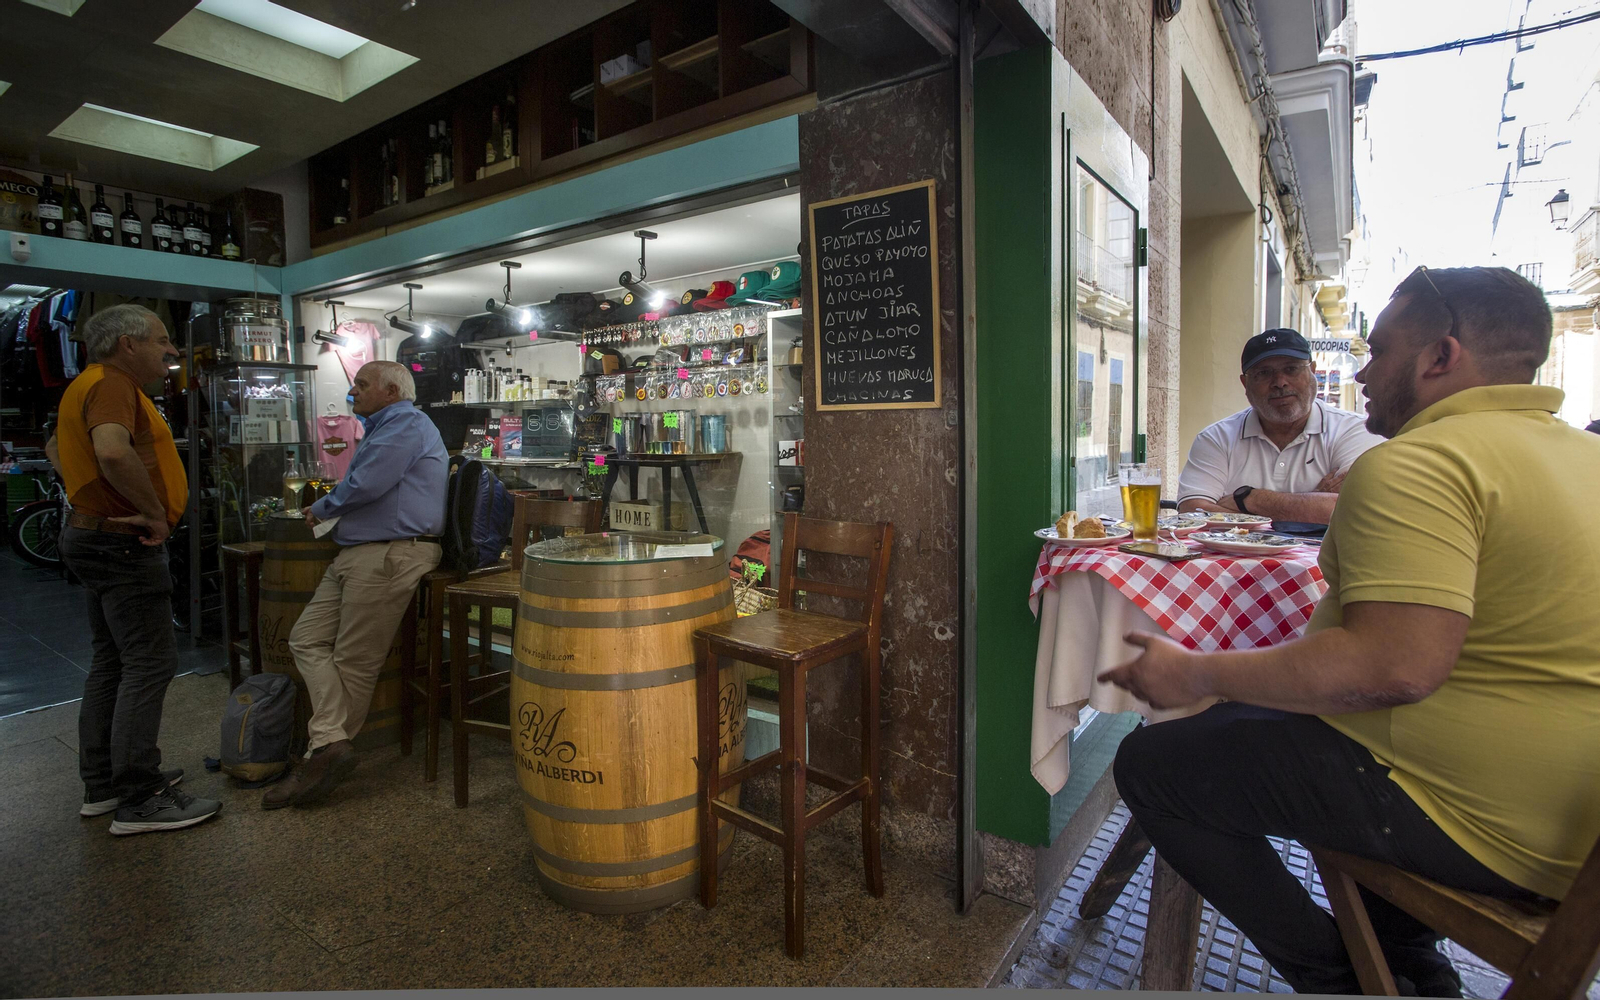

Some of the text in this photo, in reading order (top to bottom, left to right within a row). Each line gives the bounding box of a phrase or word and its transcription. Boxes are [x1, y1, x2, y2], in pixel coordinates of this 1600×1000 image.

[842, 201, 891, 219] TAPAS
[821, 229, 882, 252] PATATAS
[821, 245, 928, 271] QUESO PAYOYO
[823, 267, 895, 288] MOJAMA
[827, 284, 905, 305] ANCHOAS
[825, 308, 868, 326] ATUN
[826, 345, 916, 364] MEJILLONES
[827, 366, 933, 386] HUEVAS MARUCA
[615, 508, 651, 527] HOME
[521, 644, 575, 661] www.riojalta.com
[537, 760, 604, 784] ALBERDI
